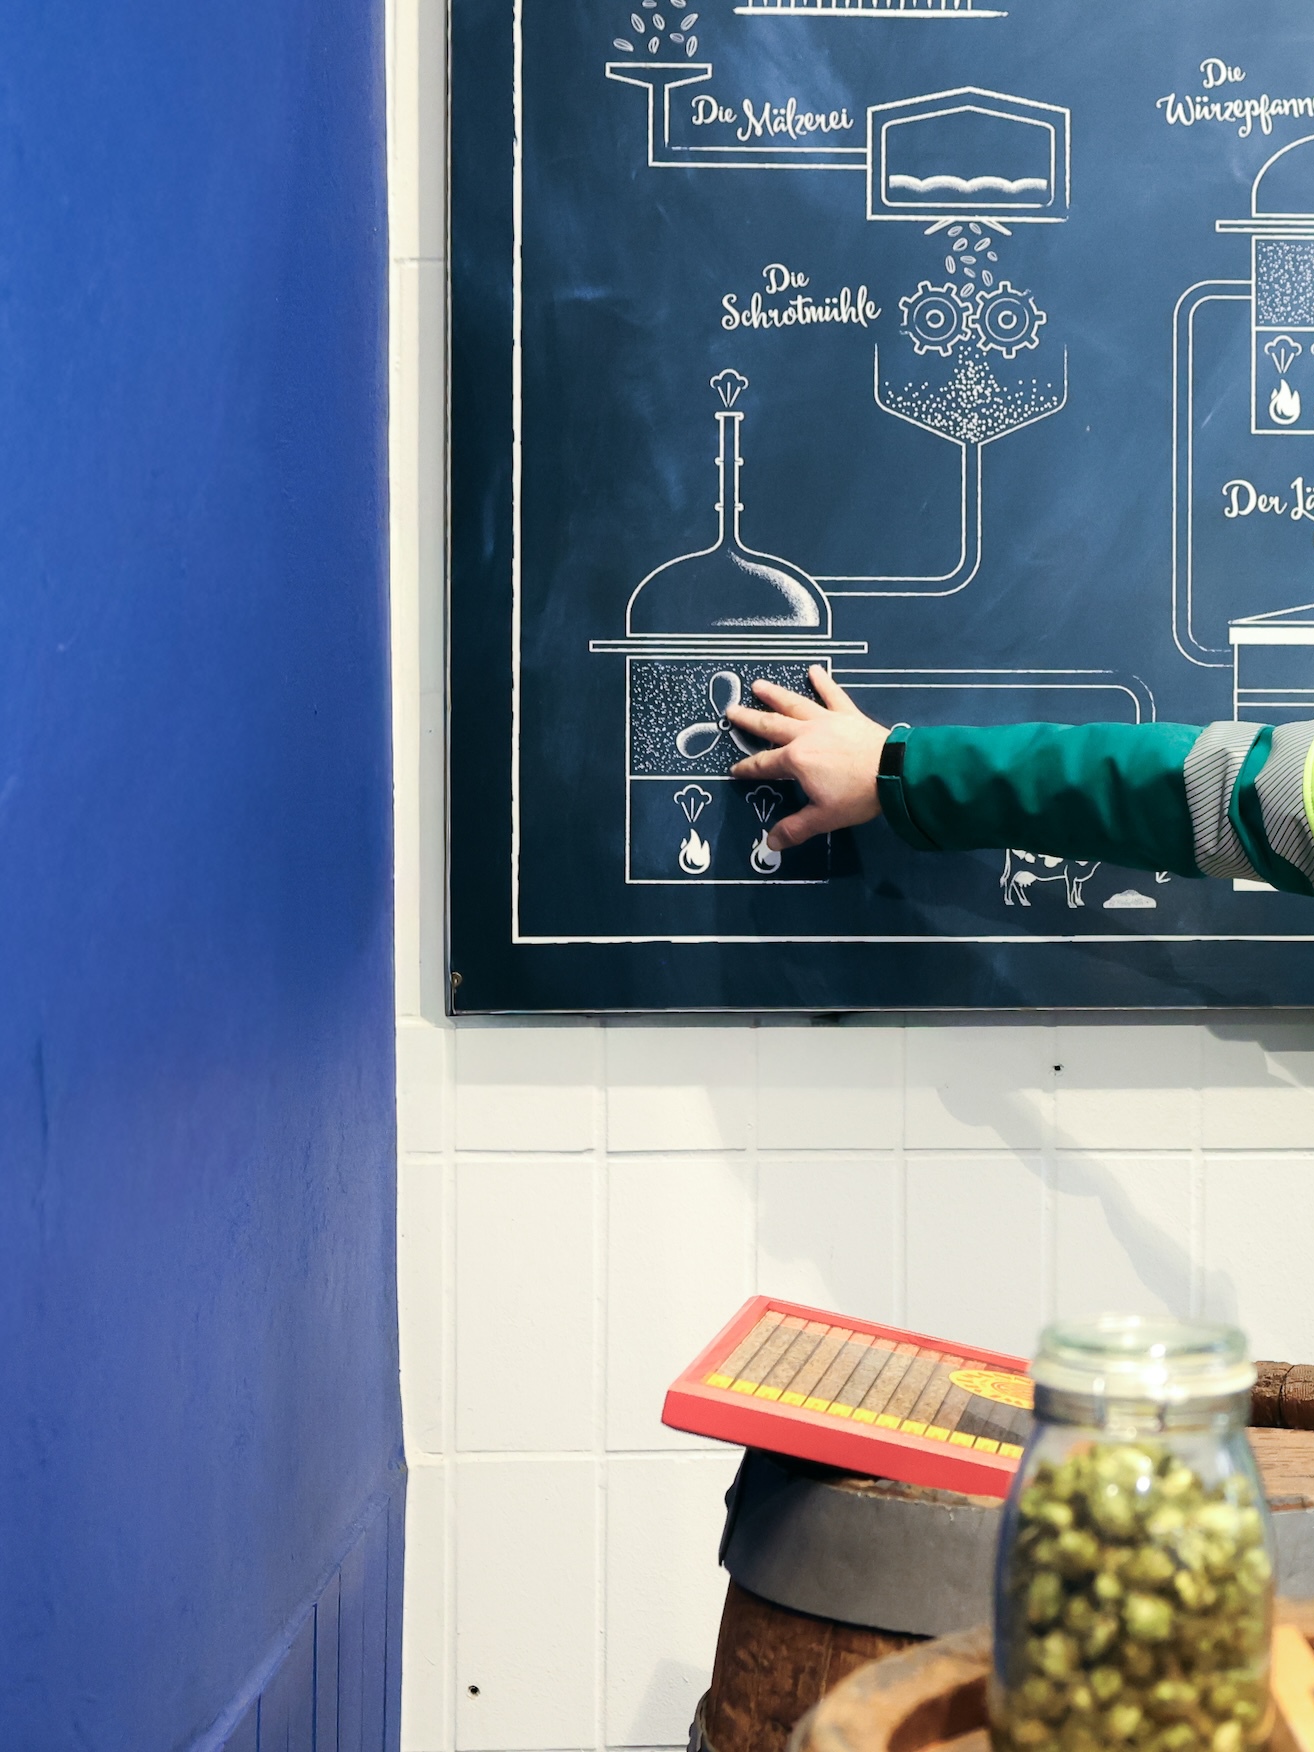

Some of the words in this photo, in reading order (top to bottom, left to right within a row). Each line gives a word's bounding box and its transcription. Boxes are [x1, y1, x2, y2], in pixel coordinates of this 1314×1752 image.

[1200, 58, 1246, 89] Die
[691, 94, 737, 125] Die
[737, 97, 854, 141] Mälzerei
[762, 263, 809, 294] Die
[721, 285, 882, 330] Schrotmühle
[1221, 479, 1287, 519] Der
